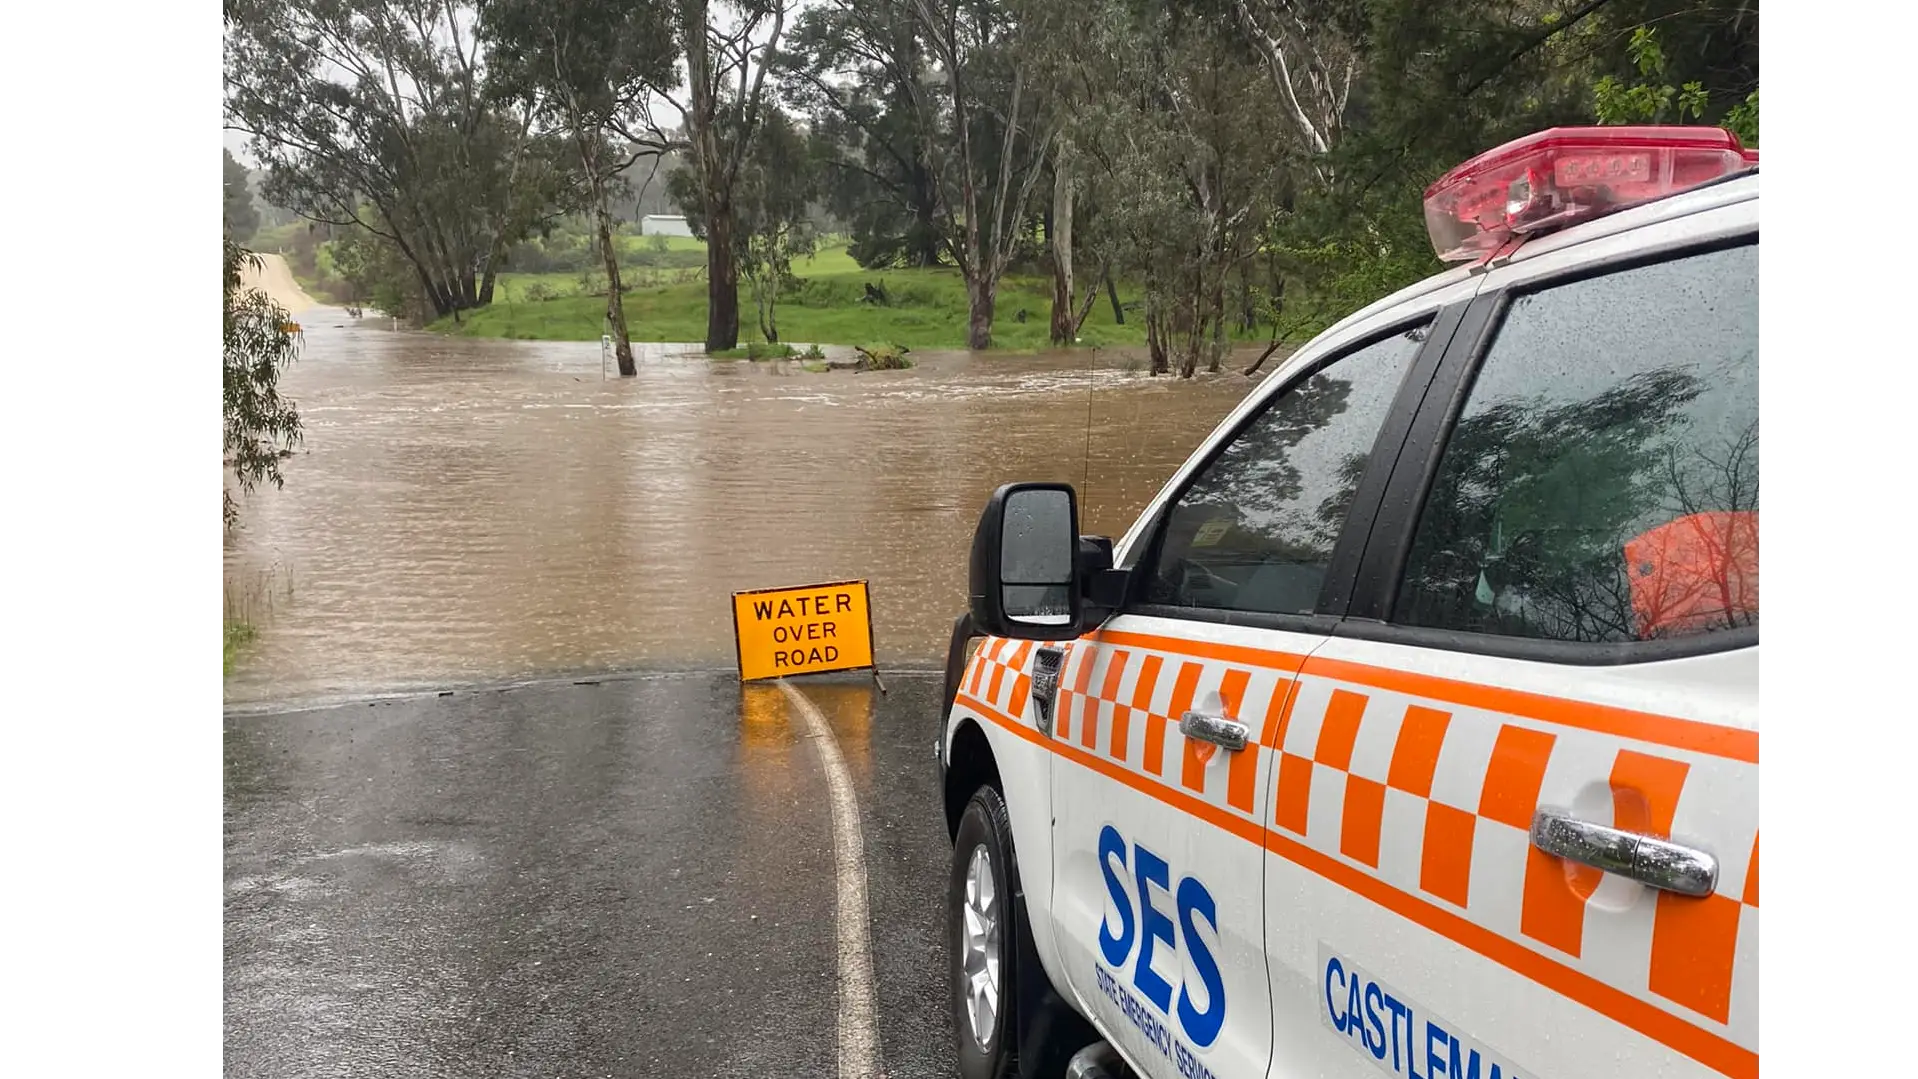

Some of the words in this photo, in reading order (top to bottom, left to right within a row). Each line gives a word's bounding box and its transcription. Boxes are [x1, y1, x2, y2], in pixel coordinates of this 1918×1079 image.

[754, 593, 851, 620] WATER
[773, 622, 837, 643] OVER
[774, 645, 839, 668] ROAD
[1098, 824, 1226, 1048] SES
[1095, 962, 1119, 1007] STATE
[1118, 985, 1173, 1062] EMERGENCY
[1174, 1039, 1216, 1079] SERV
[1326, 957, 1518, 1079] CASTLEM
